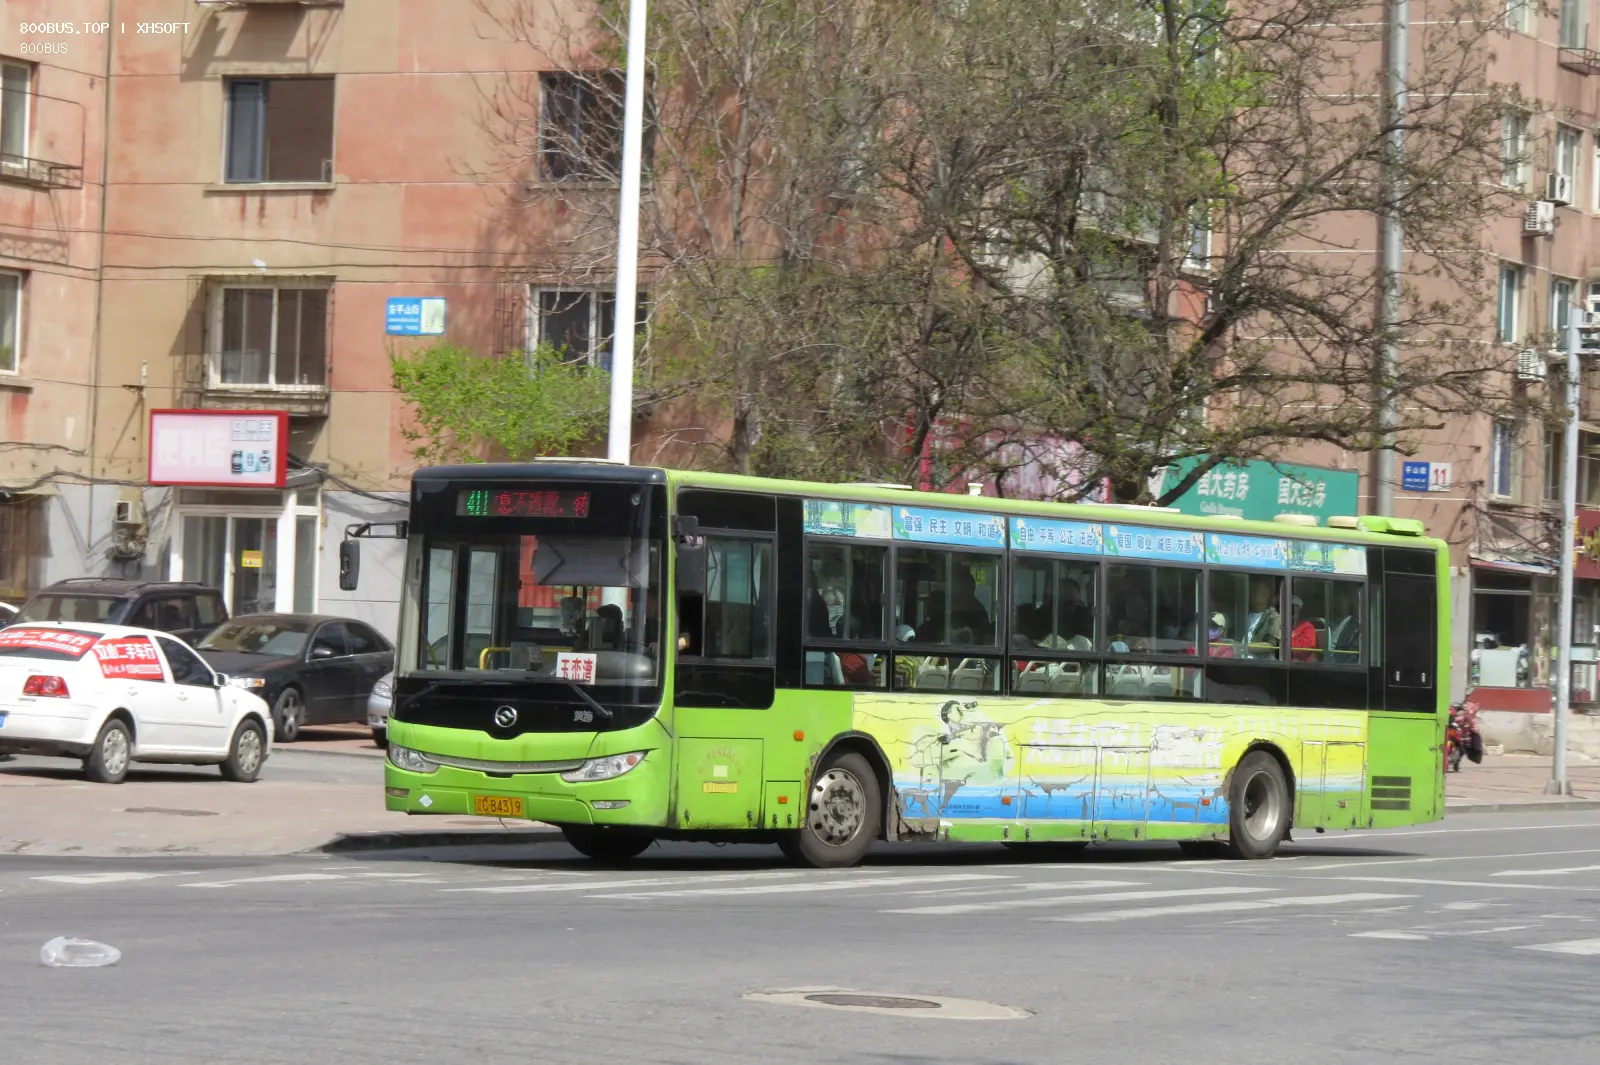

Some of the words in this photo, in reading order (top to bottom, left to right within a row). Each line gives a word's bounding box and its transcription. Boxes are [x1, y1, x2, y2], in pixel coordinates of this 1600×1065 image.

[1433, 468, 1447, 485] 11
[904, 515, 923, 533] 富强
[929, 518, 948, 534] 民主
[954, 520, 972, 537] 文明
[978, 522, 995, 539] 和谐
[1020, 526, 1035, 542] 自由
[1040, 527, 1055, 543] 平等
[1060, 529, 1074, 545] 公正
[1117, 533, 1132, 549] 爱国
[1137, 535, 1152, 550] 敬业
[1157, 537, 1172, 552] 诚信
[1176, 539, 1192, 554] 友善
